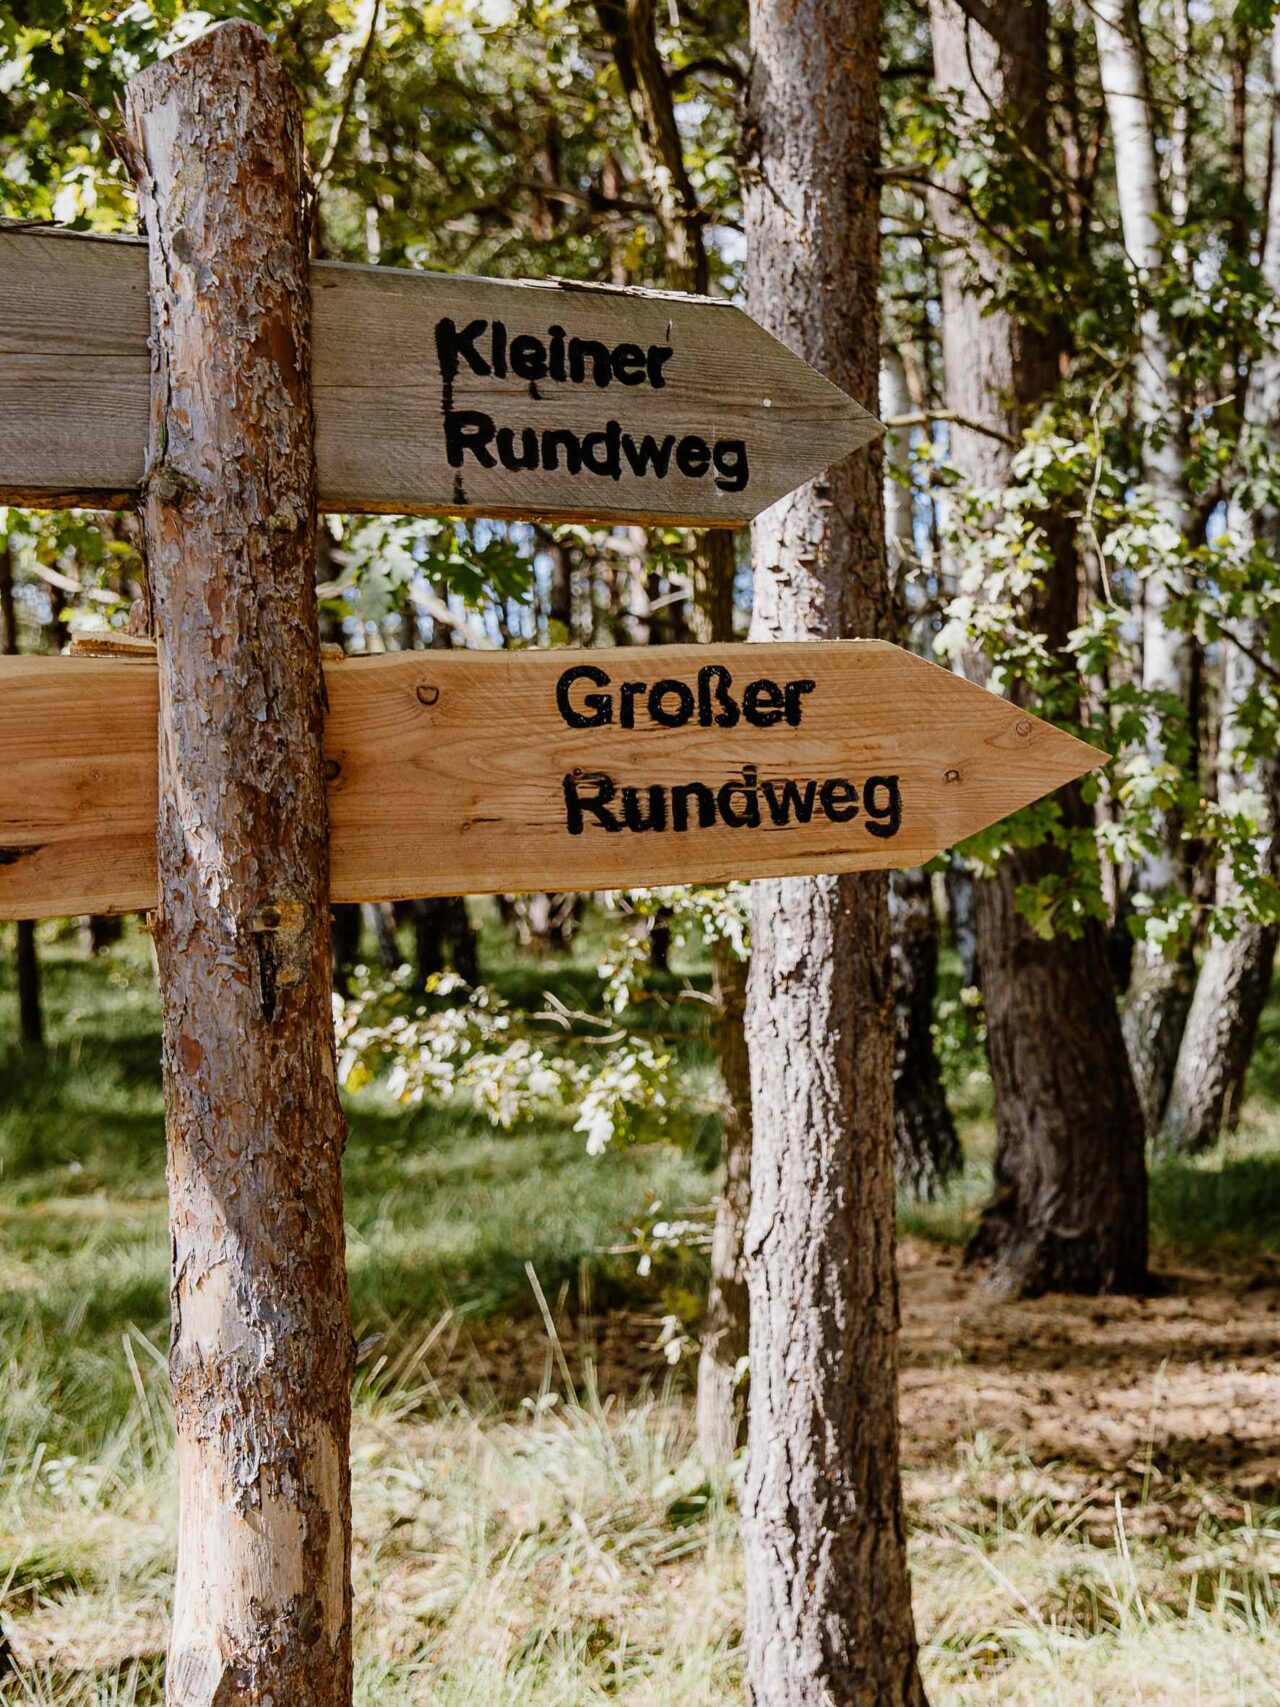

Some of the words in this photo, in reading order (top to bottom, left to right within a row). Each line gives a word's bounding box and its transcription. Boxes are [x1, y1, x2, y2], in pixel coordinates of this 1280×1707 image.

[436, 317, 674, 390] Kleiner
[443, 410, 750, 492] Rundweg
[556, 665, 816, 729] Großer
[562, 766, 903, 838] Rundweg
